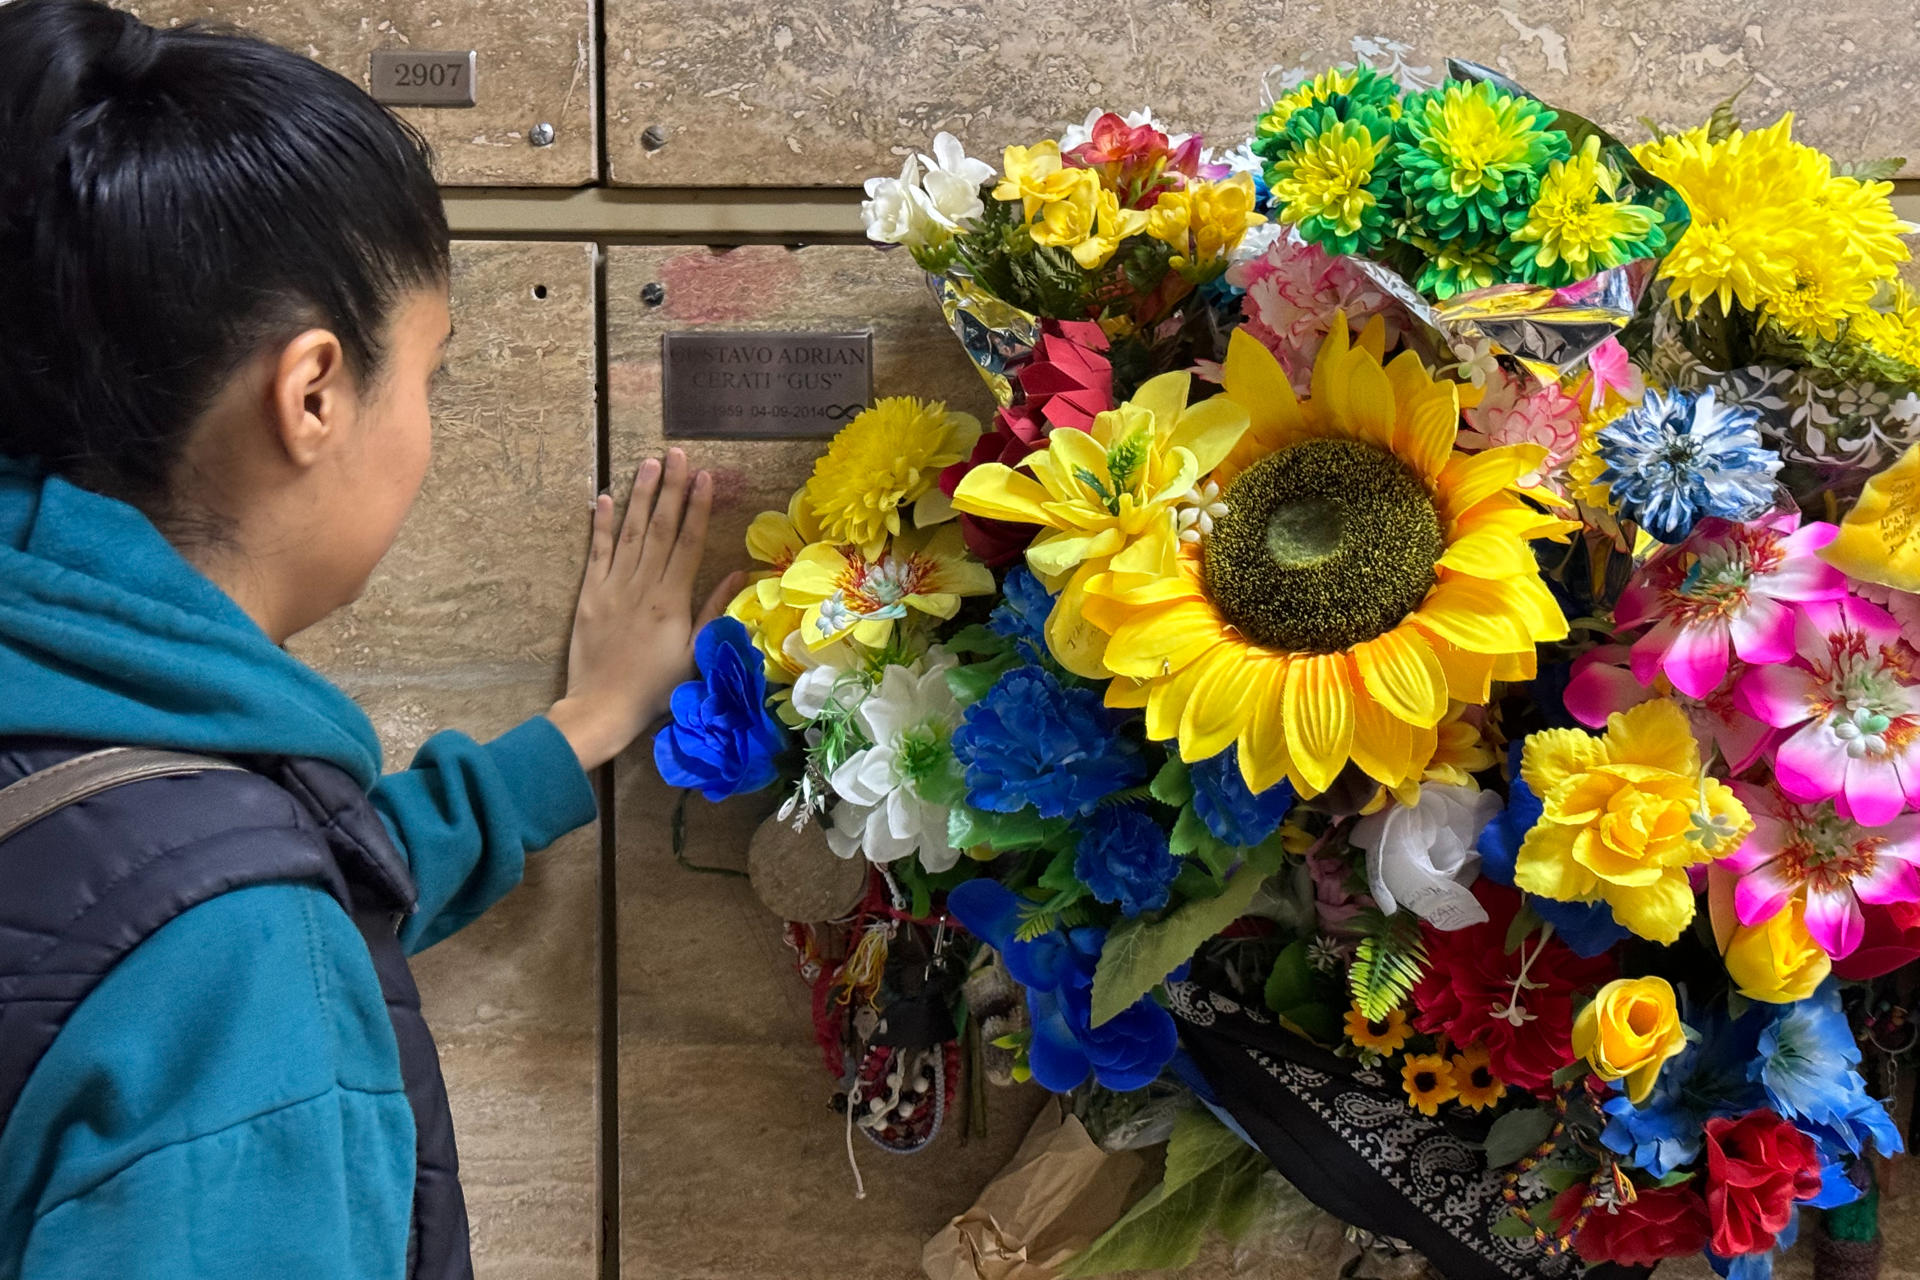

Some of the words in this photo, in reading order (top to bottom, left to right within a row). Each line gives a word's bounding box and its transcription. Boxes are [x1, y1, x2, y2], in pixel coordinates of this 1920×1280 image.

[394, 62, 463, 87] 2907
[778, 347, 865, 365] ADRIAN
[692, 372, 770, 389] CERATI
[751, 405, 825, 418] 04-09-2014
